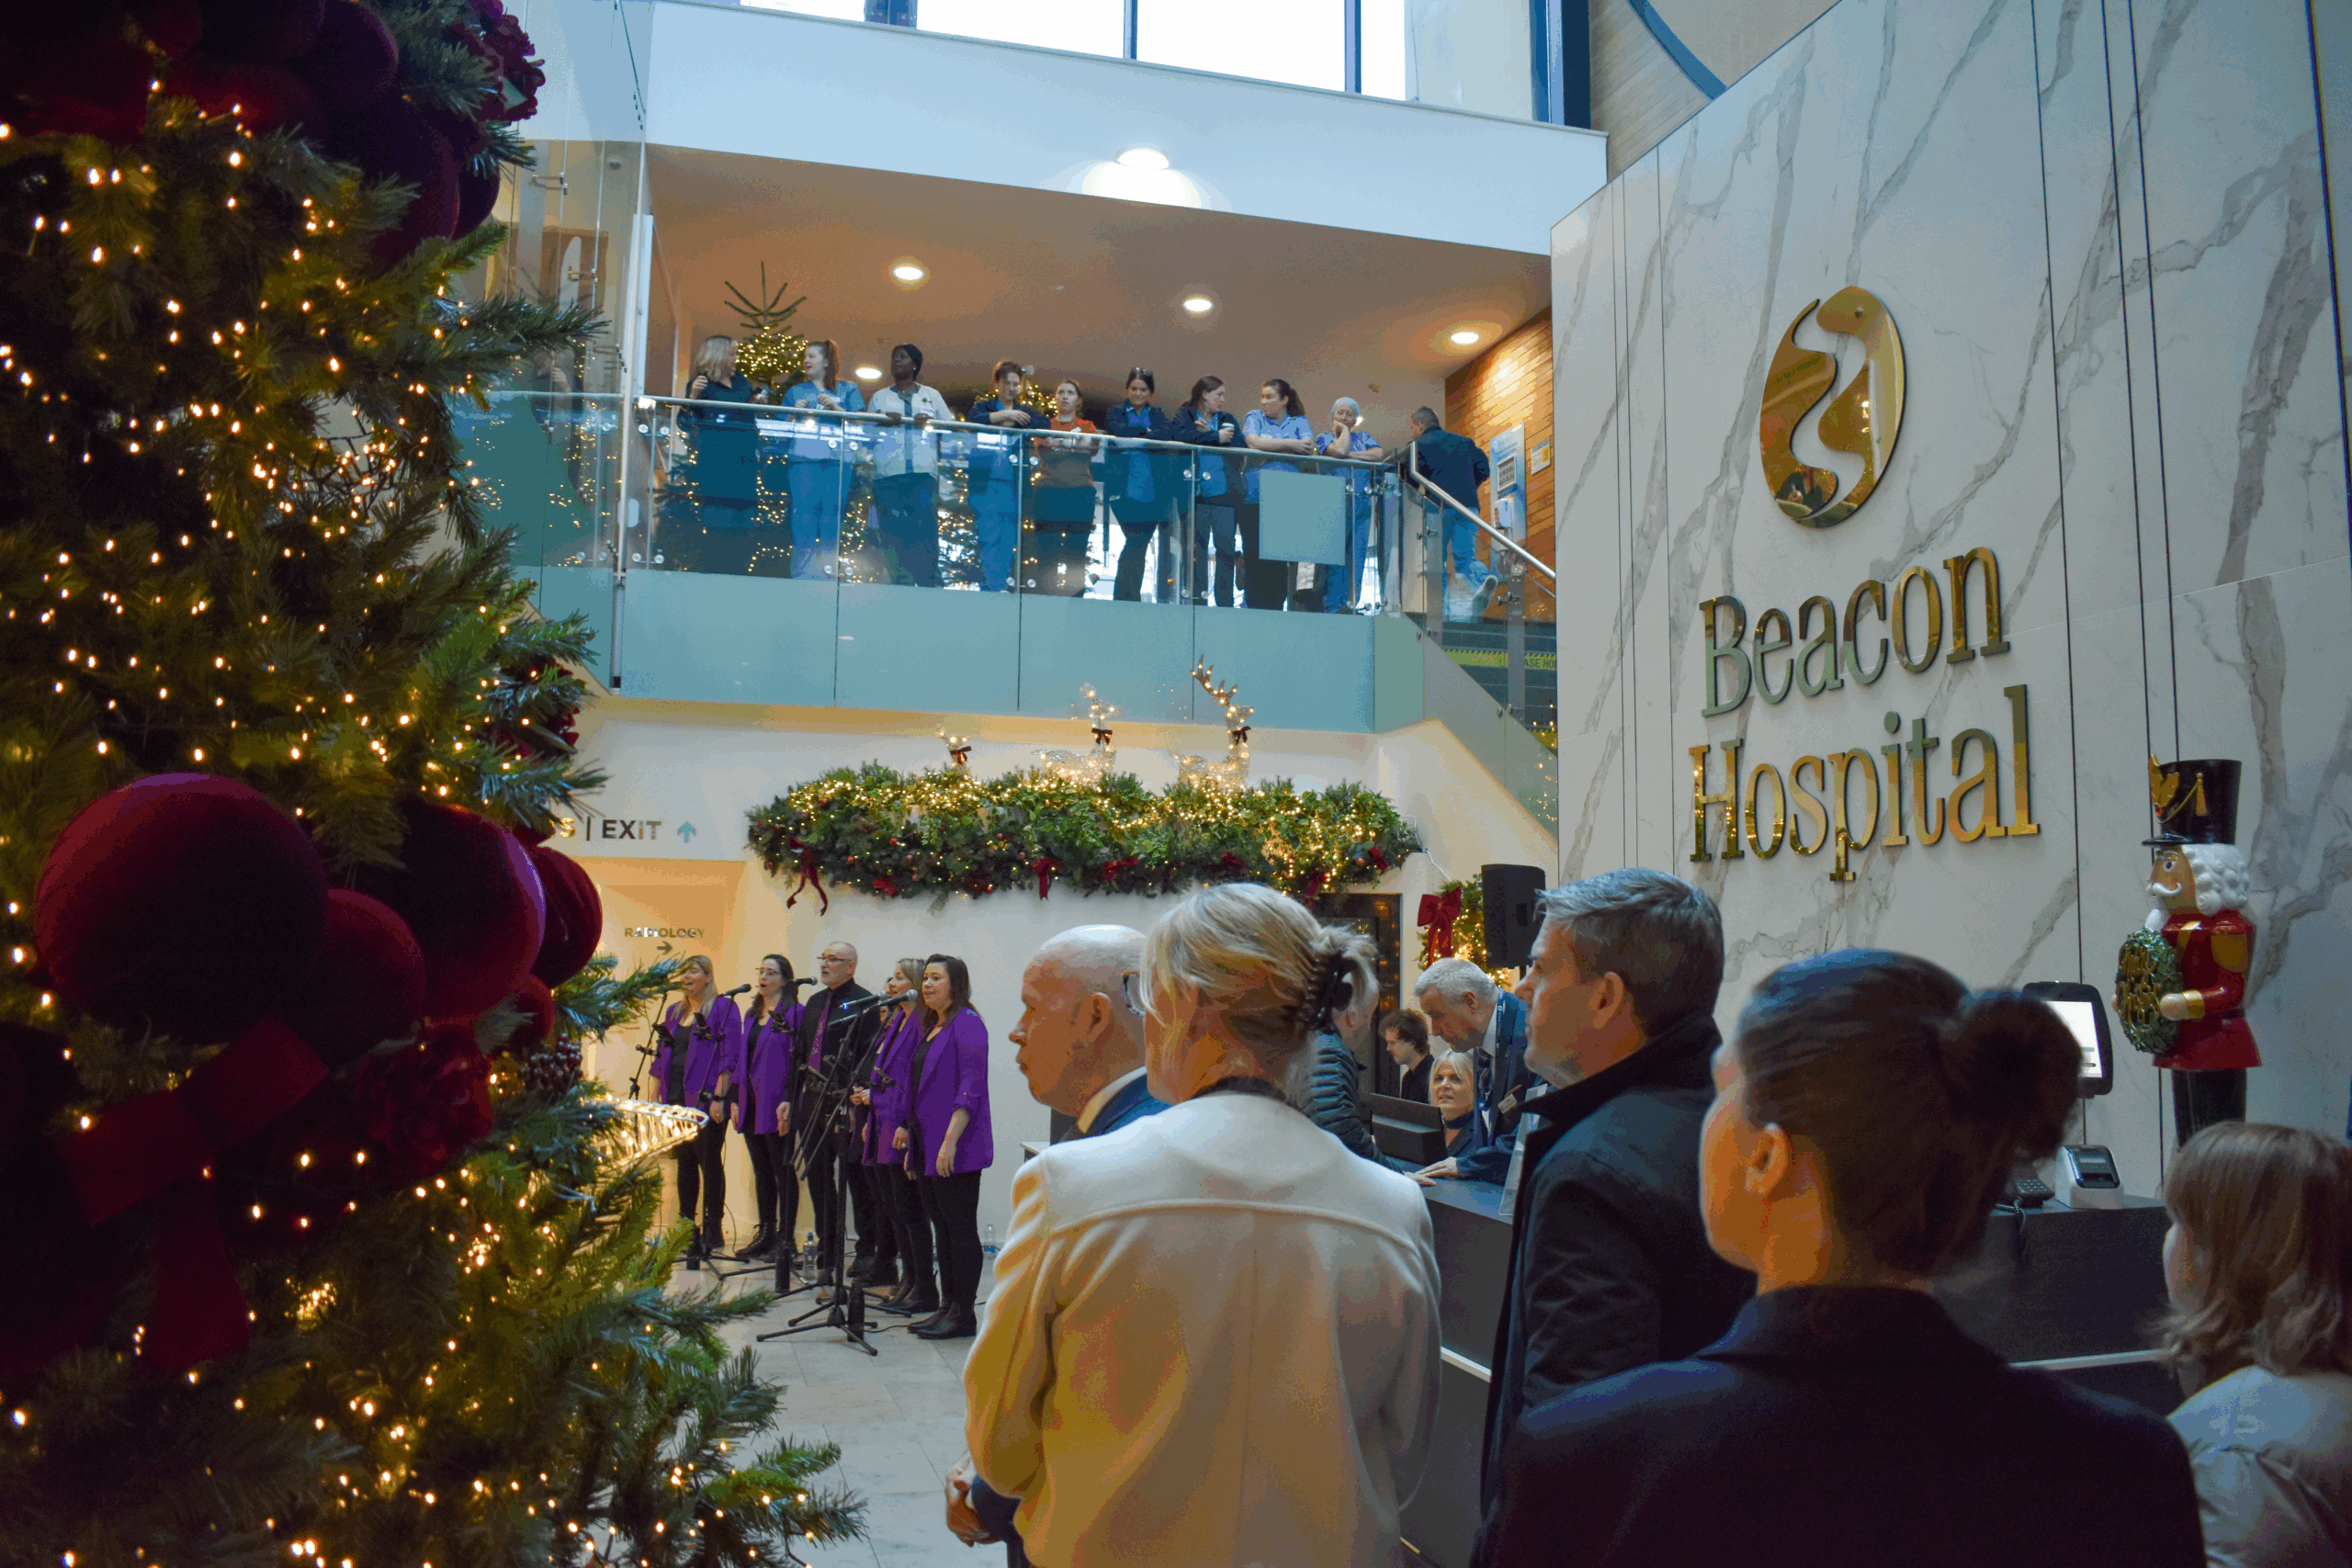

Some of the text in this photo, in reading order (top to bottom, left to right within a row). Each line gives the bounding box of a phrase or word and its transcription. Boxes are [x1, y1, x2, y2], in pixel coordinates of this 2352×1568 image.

[1699, 547, 2010, 716] Beacon
[602, 818, 662, 840] EXIT
[1688, 683, 2040, 882] Hospital
[625, 927, 705, 939] RADIOLOGY
